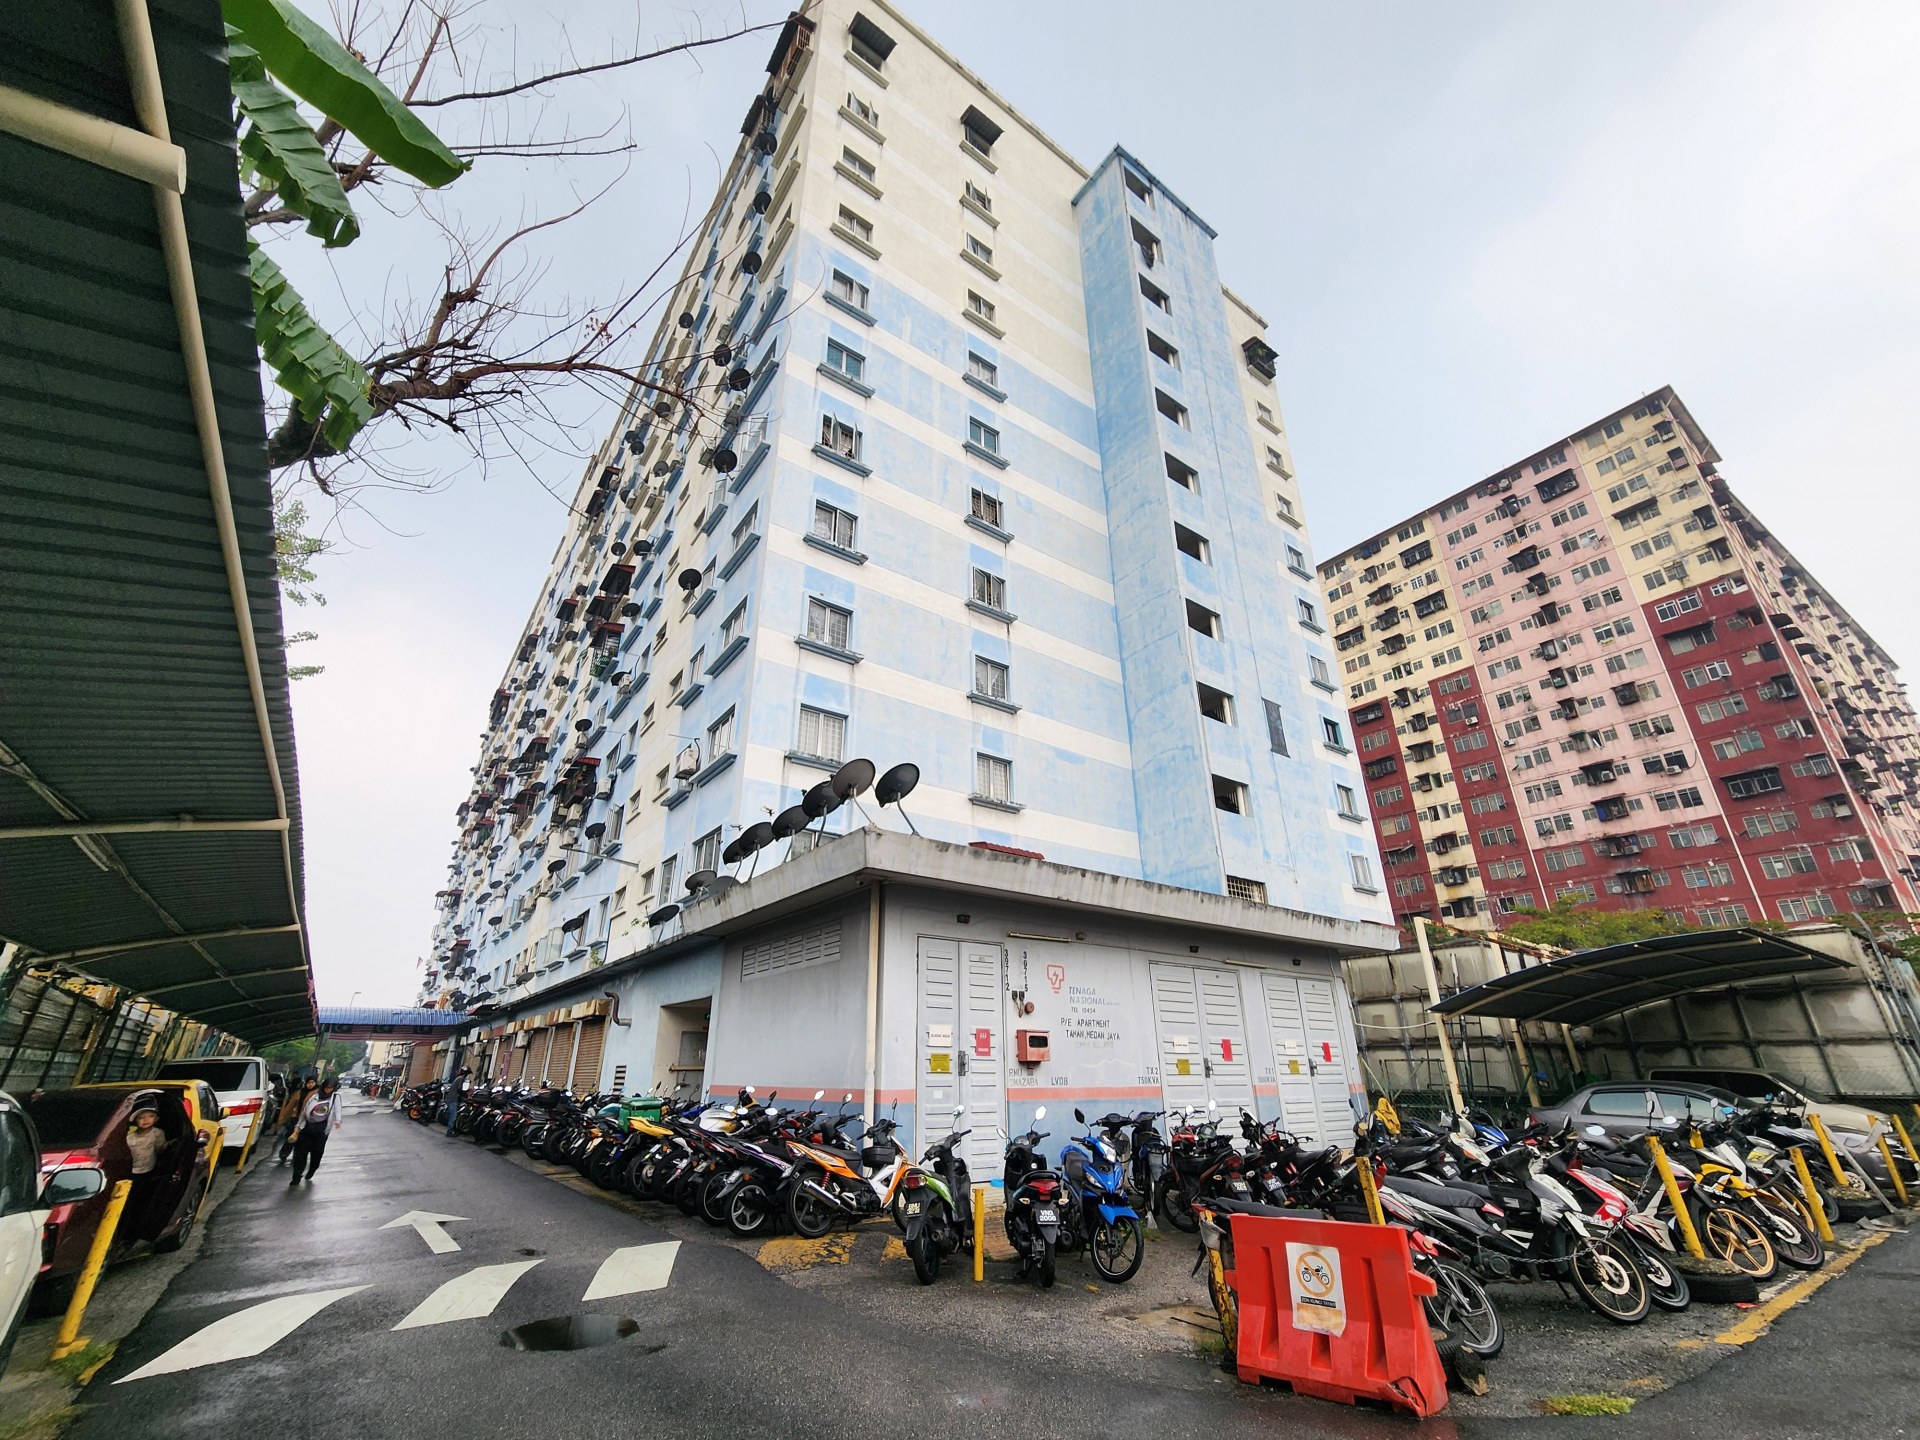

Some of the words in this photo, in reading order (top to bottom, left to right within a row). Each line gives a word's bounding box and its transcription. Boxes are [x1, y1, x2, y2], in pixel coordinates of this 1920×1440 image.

[1069, 986, 1096, 995] TENAGA
[1069, 996, 1106, 1006] NASIONAL
[1060, 1018, 1071, 1027] P/E
[1077, 1019, 1110, 1028] APARTMENT
[1107, 1032, 1120, 1040] JAYA
[1051, 1076, 1069, 1086] LVDB
[1138, 1076, 1160, 1085] 750KVA
